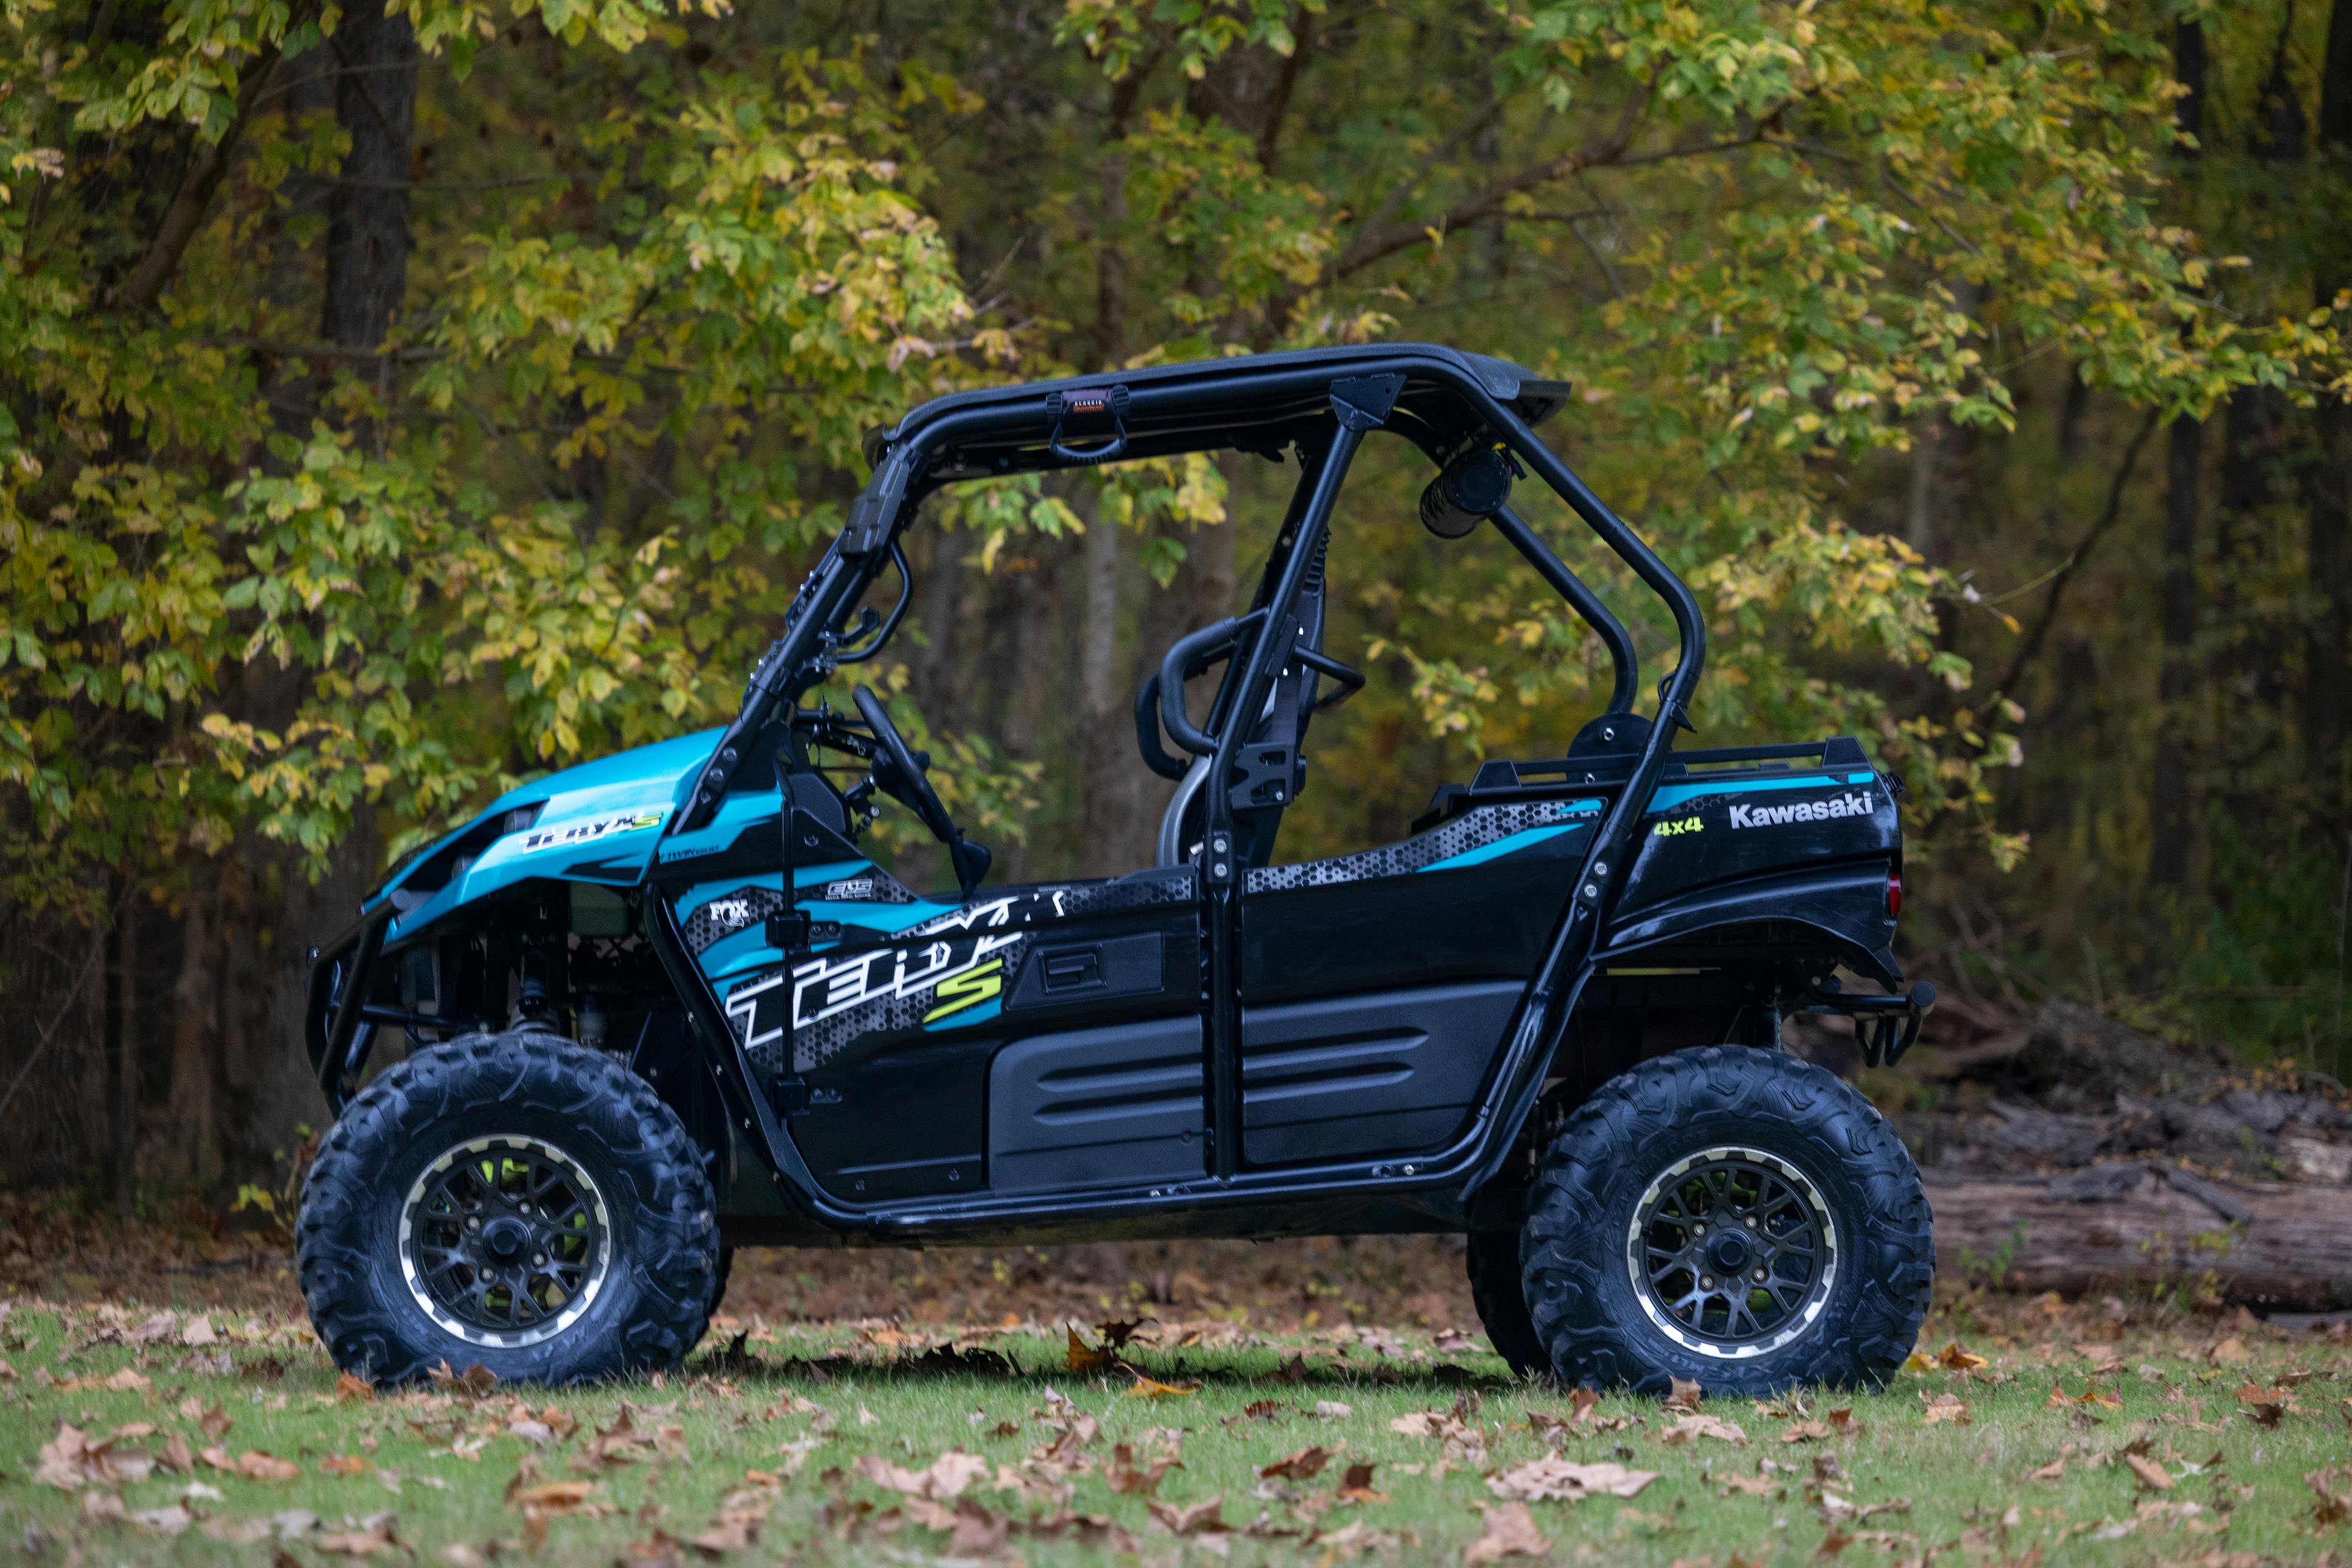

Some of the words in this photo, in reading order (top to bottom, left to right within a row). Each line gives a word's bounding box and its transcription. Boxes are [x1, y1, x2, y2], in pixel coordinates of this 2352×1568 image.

[1654, 816, 1704, 837] 4x4
[1729, 791, 1873, 829] Kawasaki
[709, 899, 749, 927] FOX
[922, 957, 1003, 1023] S
